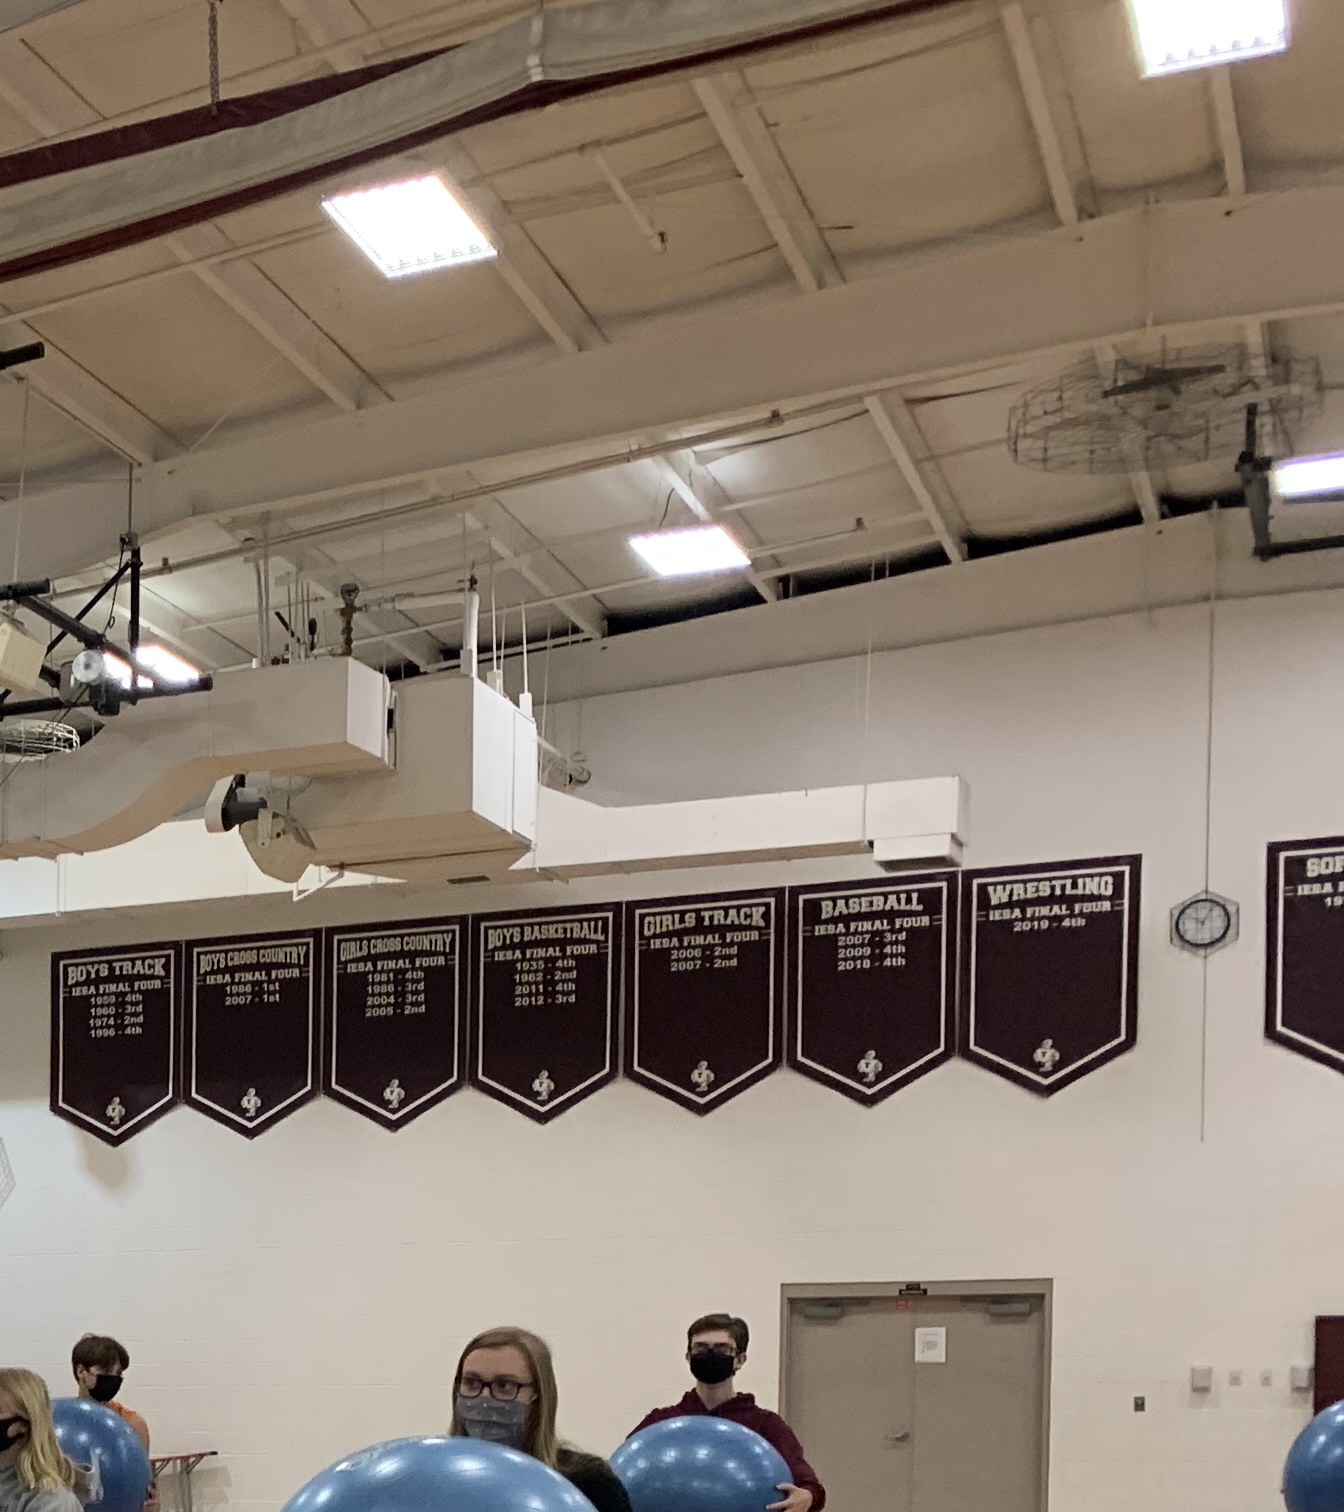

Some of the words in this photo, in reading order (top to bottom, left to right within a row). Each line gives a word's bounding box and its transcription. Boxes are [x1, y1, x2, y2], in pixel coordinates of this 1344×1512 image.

[987, 875, 1113, 905] WRESTLING
[821, 892, 923, 919] BASEBALL
[1026, 904, 1070, 918] FINAL
[1074, 901, 1111, 914] FOUR
[644, 912, 696, 936] GIRLS
[701, 906, 765, 927] TRACK
[850, 920, 891, 932] FINAL
[895, 916, 930, 928] FOUR
[1062, 917, 1086, 927] 4th
[488, 927, 521, 950] BOYS
[524, 920, 605, 941] BASKETBALL
[683, 934, 722, 946] FINAL
[726, 931, 759, 942] FOUR
[838, 934, 871, 946] 2007
[884, 931, 906, 943] 3rd
[341, 940, 368, 961] GIRLS
[370, 937, 401, 954] CROSS
[403, 933, 452, 952] COUNTRY
[526, 947, 562, 958] FINAL
[566, 944, 597, 956] FOUR
[714, 945, 738, 956] 2nd
[838, 947, 871, 958] 2009
[883, 944, 905, 954] 4th
[200, 953, 225, 974] BOYS
[227, 950, 257, 966] CROSS
[260, 946, 306, 964] COUNTRY
[377, 958, 412, 970] FINAL
[415, 956, 445, 967] FOUR
[556, 958, 576, 967] 4th
[671, 960, 701, 971] 2007
[714, 958, 738, 968] 2nd
[883, 957, 905, 966] 4th
[68, 963, 109, 985] BOYS
[112, 958, 165, 976] TRACK
[235, 971, 268, 982] FINAL
[272, 968, 299, 979] FOUR
[405, 970, 424, 979] 4th
[554, 970, 577, 980] 2nd
[99, 982, 131, 994] FINAL
[134, 980, 161, 990] FOUR
[263, 982, 279, 991] 1st
[405, 982, 424, 991] 3rd
[515, 984, 543, 994] 2011
[556, 982, 576, 991] 4th
[125, 993, 142, 1002] 4th
[225, 995, 252, 1005] 2007
[263, 993, 279, 1002] 1st
[367, 995, 395, 1005] 2004
[405, 993, 424, 1002] 3rd
[514, 996, 544, 1006] 2012
[555, 994, 576, 1004] 3rd
[125, 1004, 142, 1013] 3rd
[404, 1005, 425, 1015] 2nd
[89, 1017, 114, 1026] 1974
[124, 1014, 143, 1024] 2nd
[125, 1026, 142, 1034] 4th
